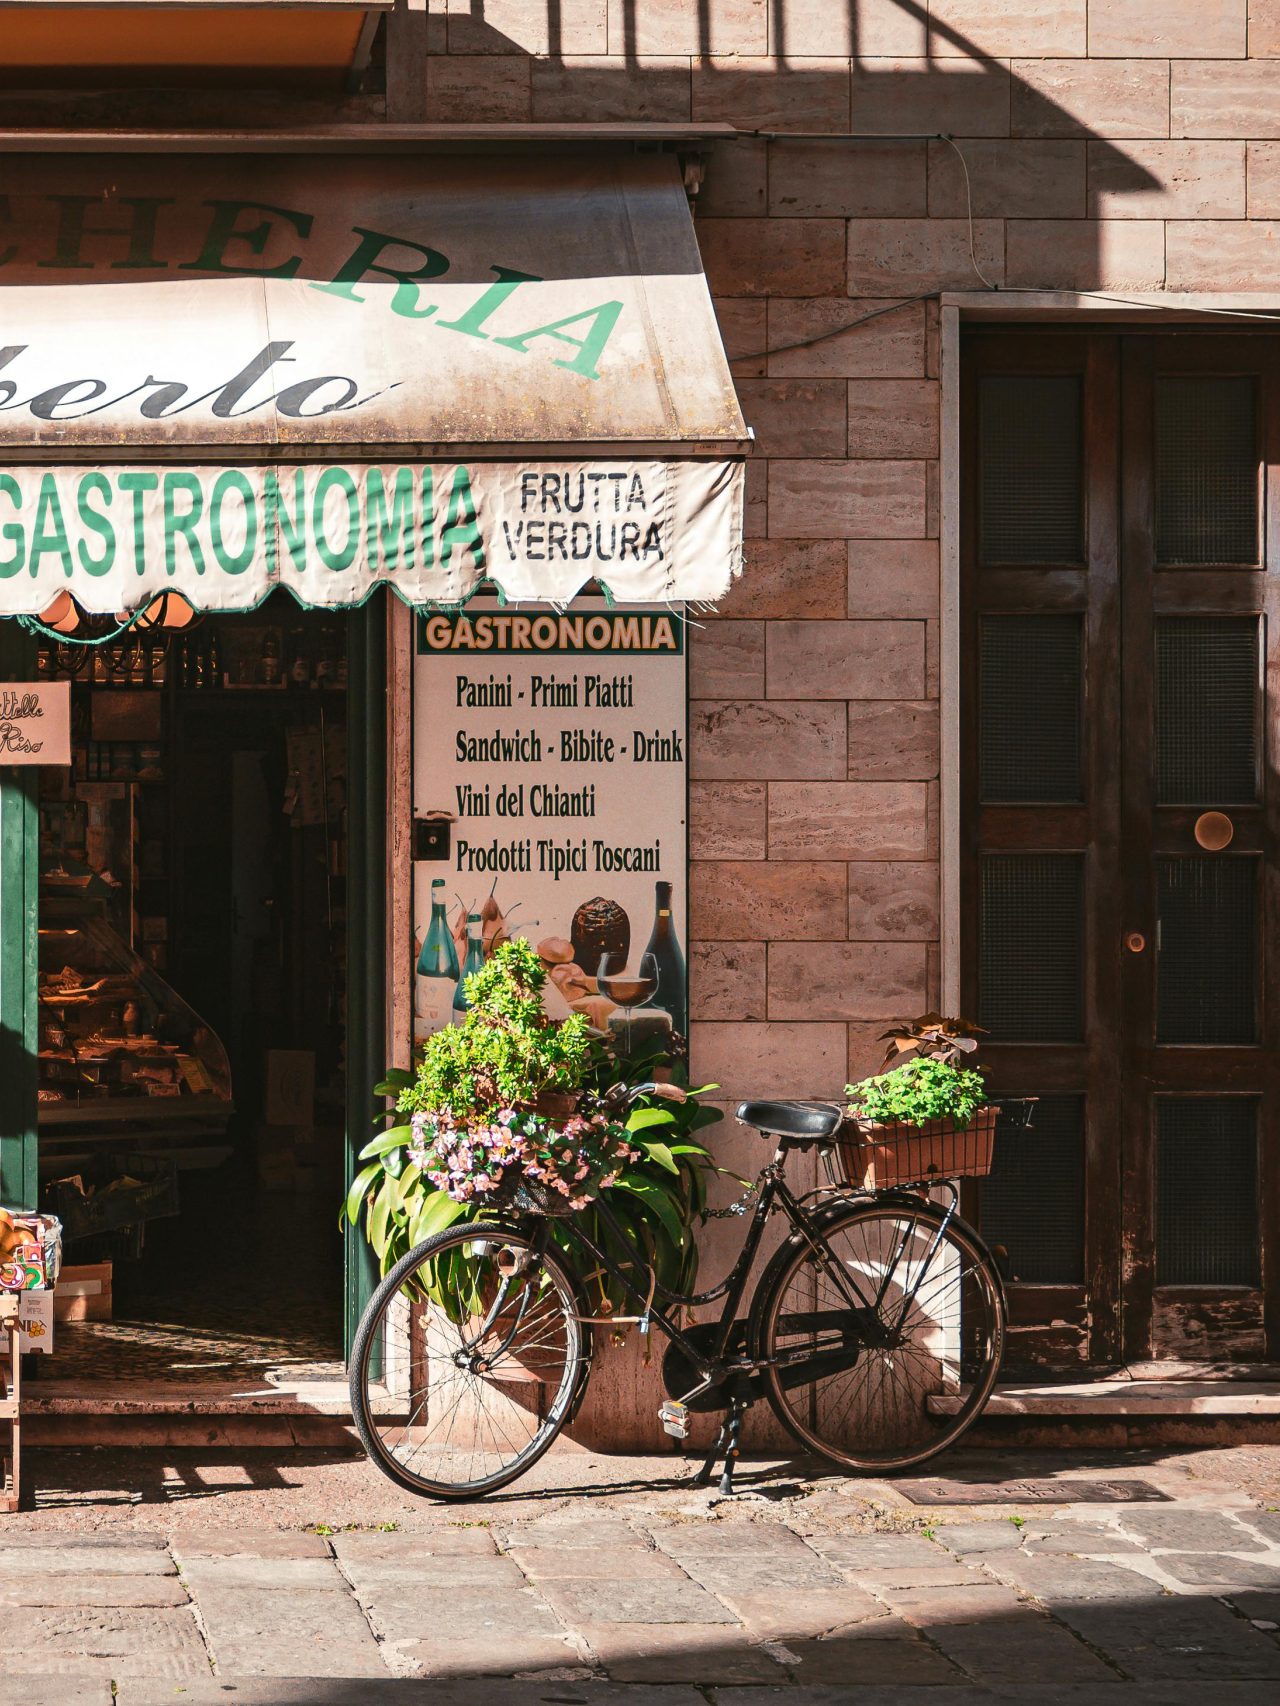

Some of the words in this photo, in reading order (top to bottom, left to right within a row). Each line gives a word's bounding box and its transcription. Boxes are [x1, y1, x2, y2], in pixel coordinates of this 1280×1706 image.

[520, 472, 646, 514] FRUTTA
[503, 520, 665, 563] VERDURA
[426, 616, 676, 649] GASTRONOMIA
[456, 674, 512, 707] Panini
[531, 674, 578, 707] Primi
[584, 674, 633, 707] Piatti
[456, 729, 542, 762] Sandwich
[560, 729, 615, 762] Bibite
[633, 729, 683, 762] Drink
[456, 784, 490, 816] Vini
[496, 784, 524, 816] del
[530, 784, 596, 817] Chianti
[457, 839, 531, 872] Prodotti
[537, 839, 587, 880] Tipici
[593, 839, 660, 872] Toscani
